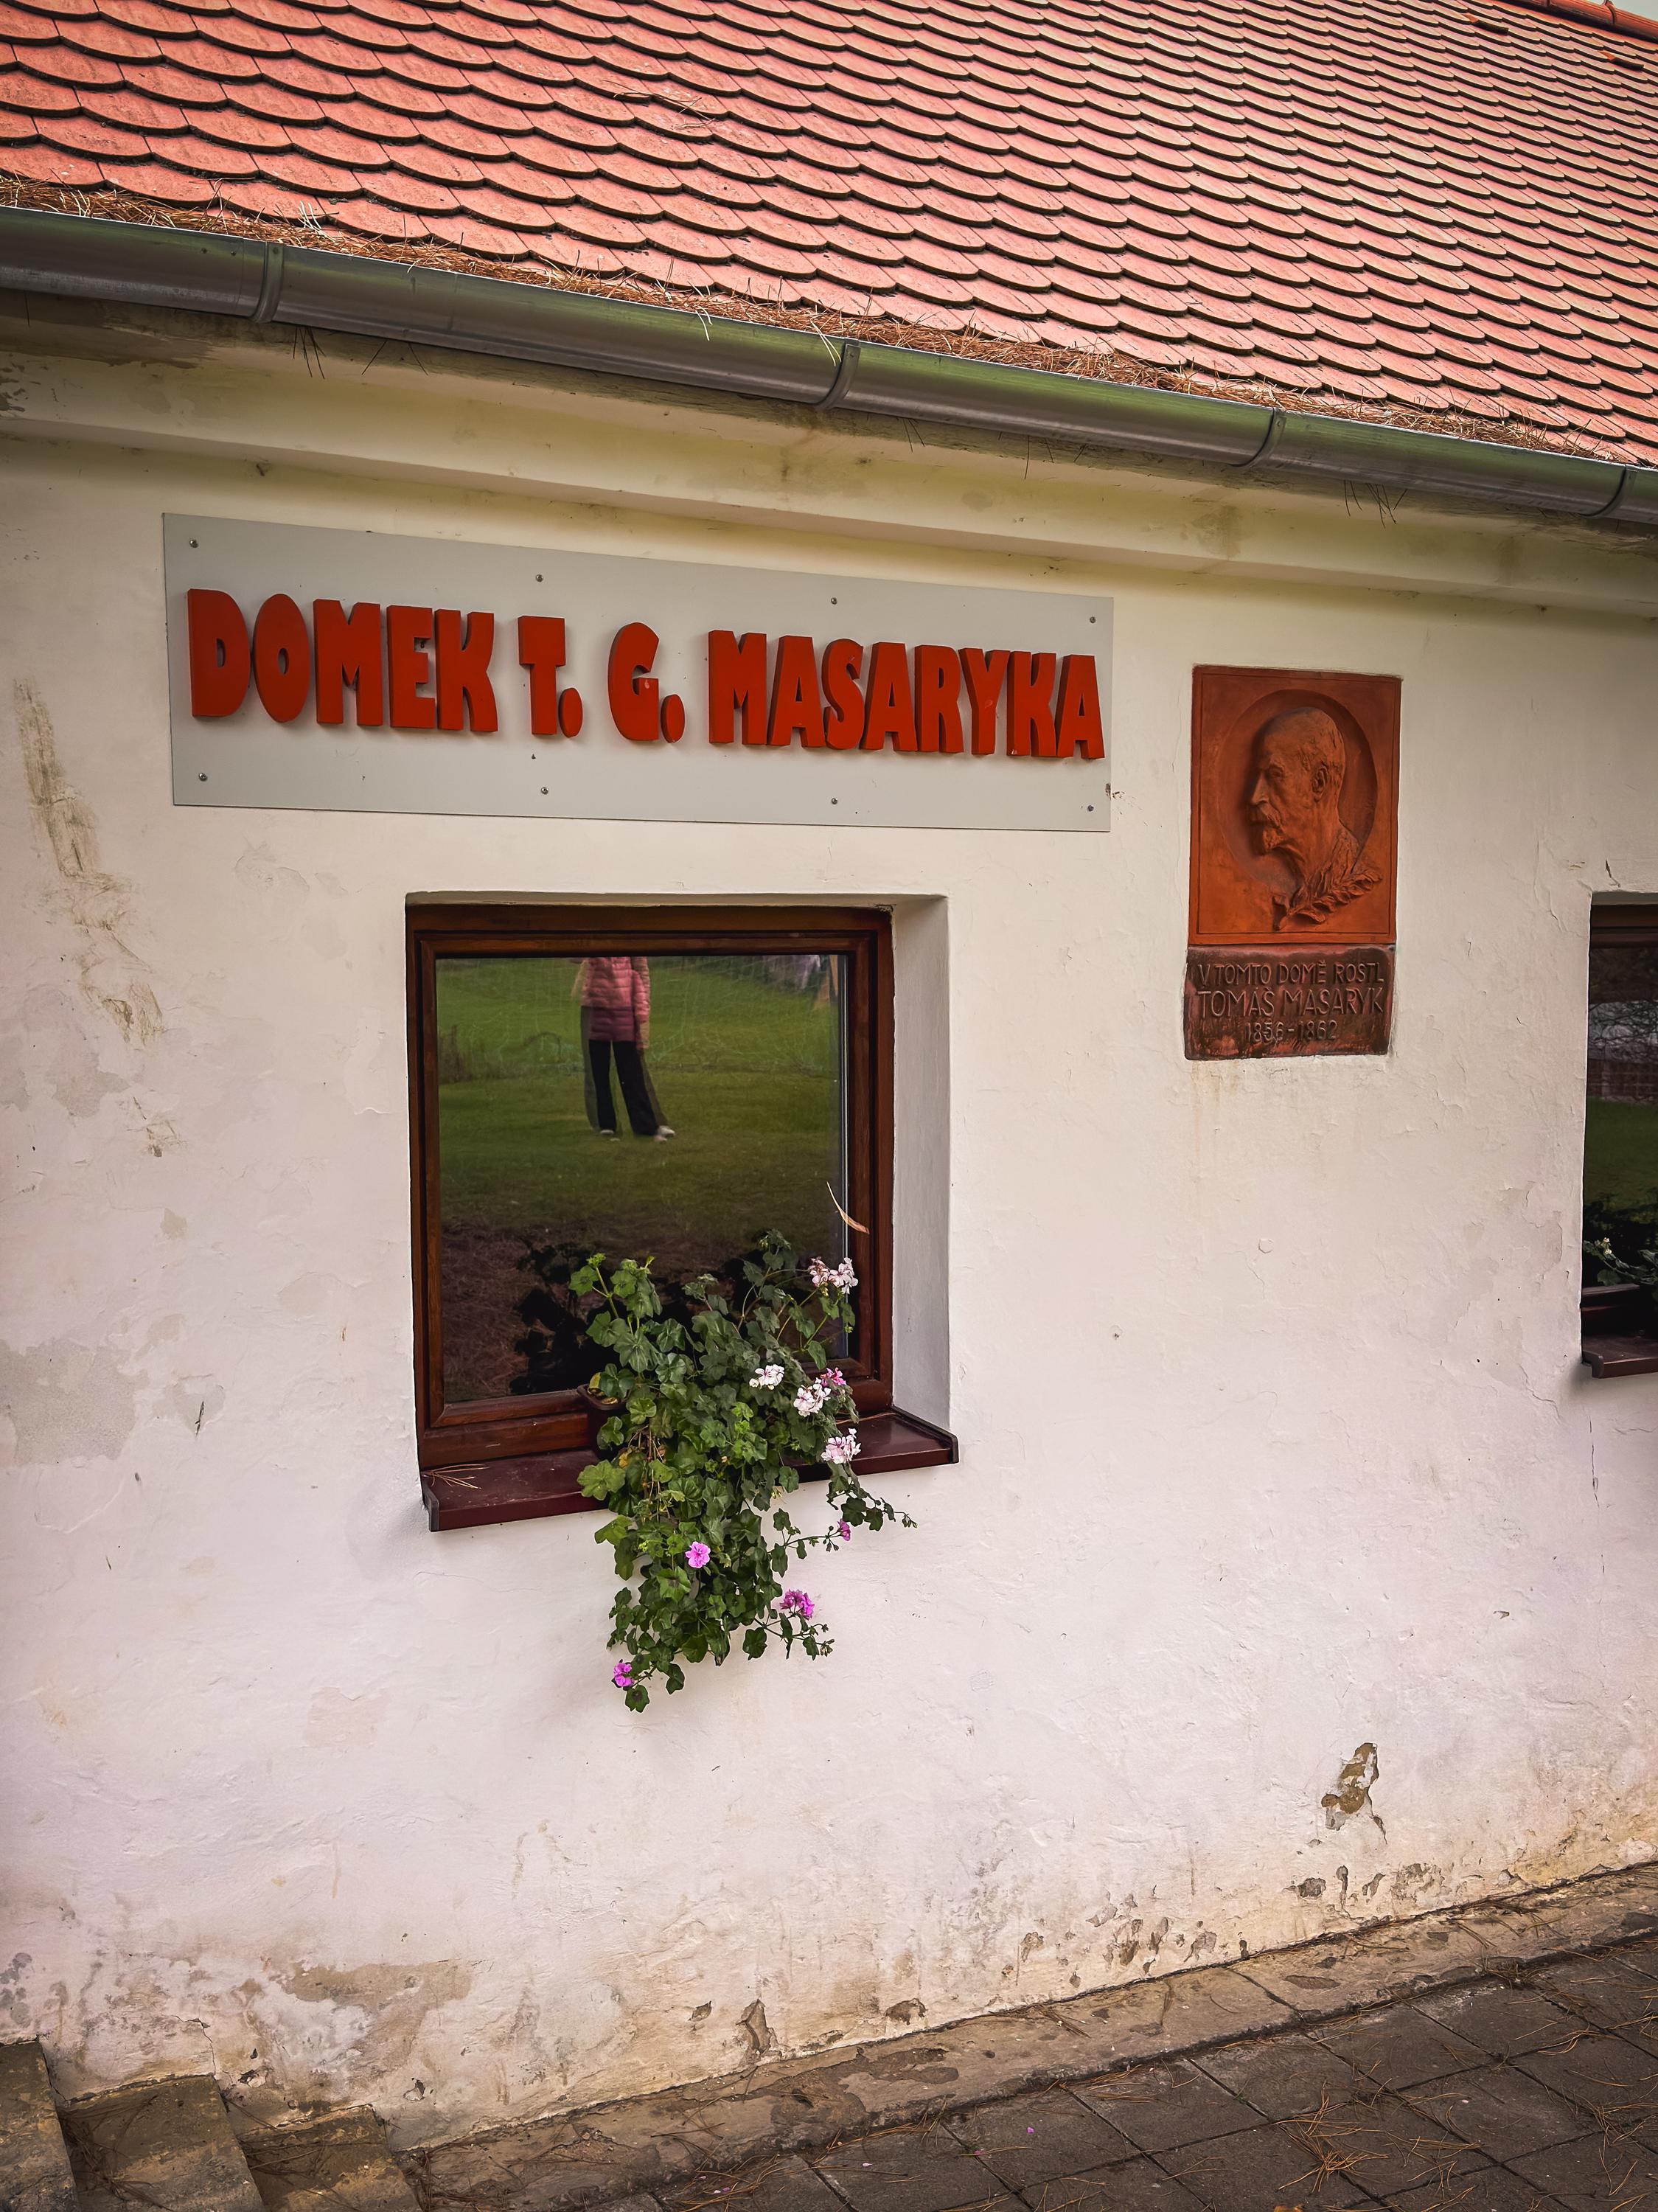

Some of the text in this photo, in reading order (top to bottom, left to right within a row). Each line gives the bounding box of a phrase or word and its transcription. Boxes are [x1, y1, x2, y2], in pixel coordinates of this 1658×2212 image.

[187, 588, 1106, 759] DOMEK T. G. MASARYKA
[1198, 959, 1384, 987] V TOMTO DOMĚ ROSTL
[1197, 986, 1384, 1018] TOMÁŠ MASARYK
